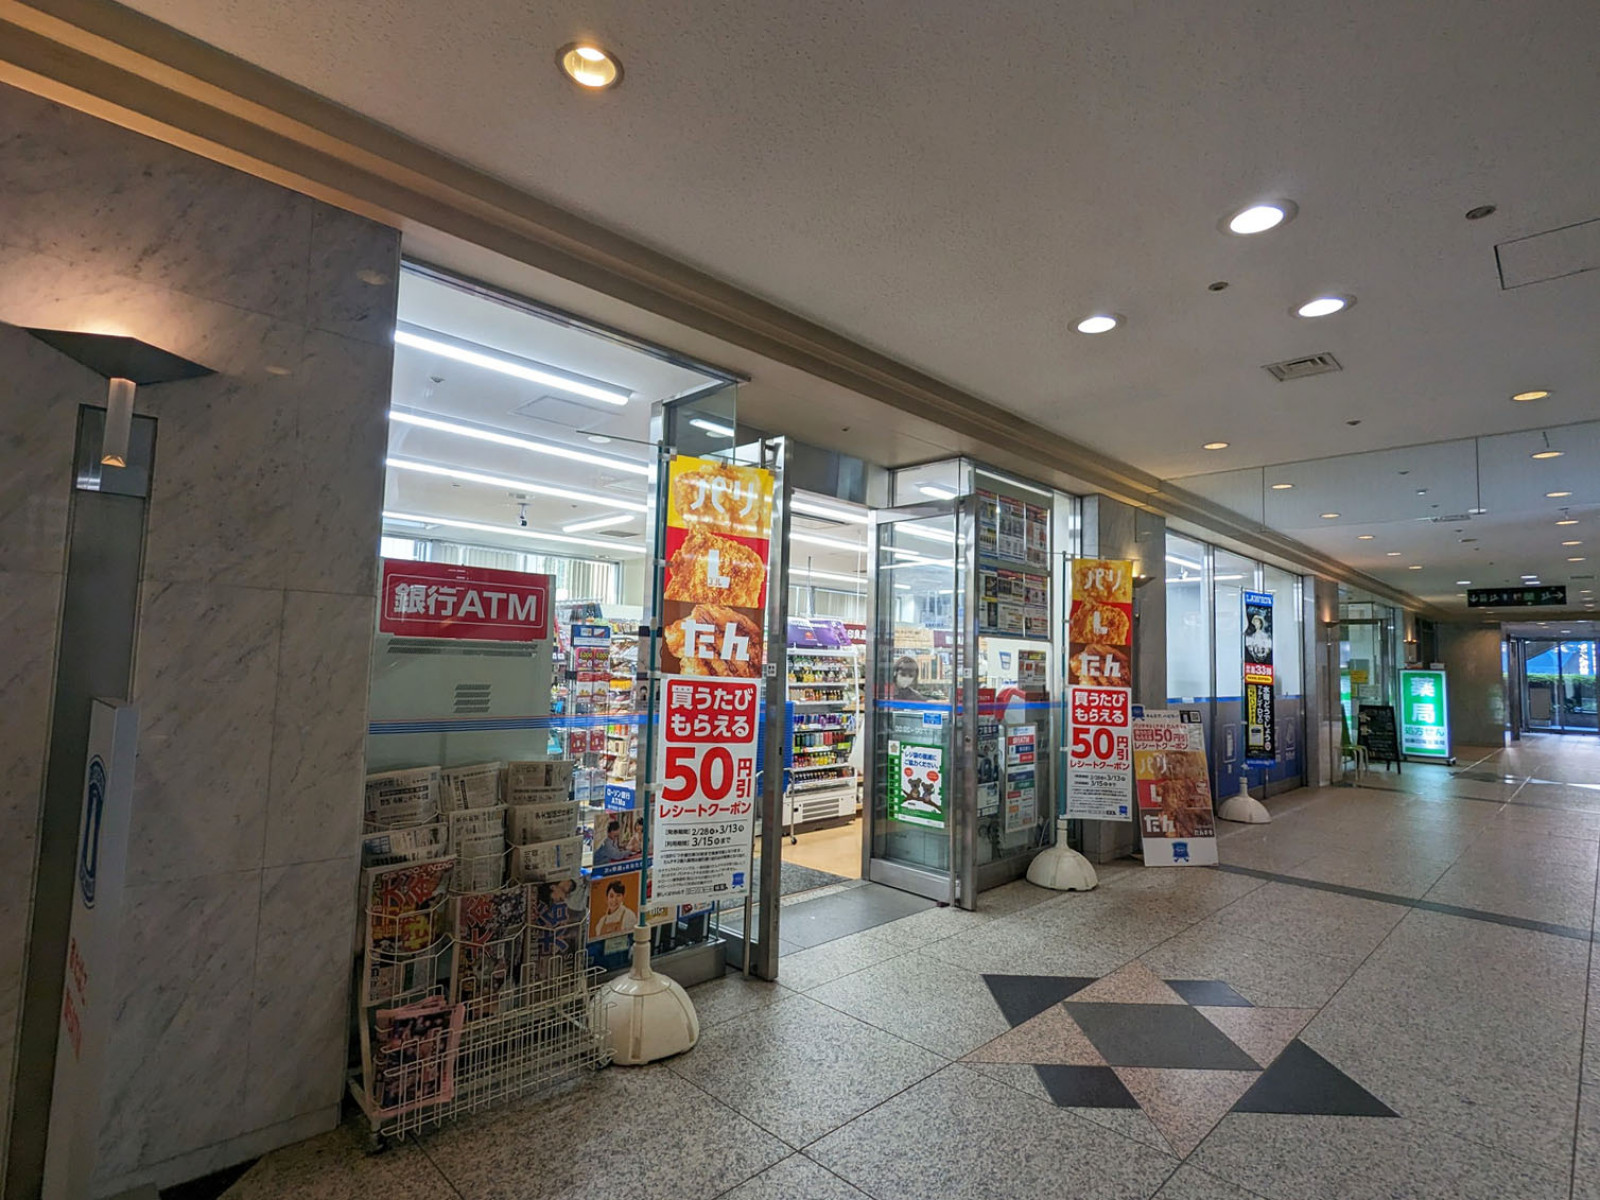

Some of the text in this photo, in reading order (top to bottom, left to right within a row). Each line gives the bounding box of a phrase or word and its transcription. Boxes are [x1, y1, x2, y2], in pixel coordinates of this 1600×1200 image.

[691, 475, 753, 517] パリ
[1084, 567, 1122, 593] パリ
[394, 582, 537, 622] 銀行ATM
[681, 618, 750, 662] たん
[1079, 652, 1121, 678] たん
[670, 684, 754, 710] 買うたび
[1075, 691, 1125, 706] 買うたび
[1411, 677, 1435, 724] 薬局
[670, 713, 750, 738] もらえる
[1075, 709, 1125, 724] もらえる
[1071, 727, 1129, 761] 50円引
[1134, 742, 1189, 750] レシートクーポン
[661, 746, 753, 802] 50円引
[1070, 760, 1130, 771] レシートクーポン
[660, 801, 752, 819] レシートクーポン
[1144, 815, 1176, 834] たん
[692, 836, 731, 847] 3/15まで
